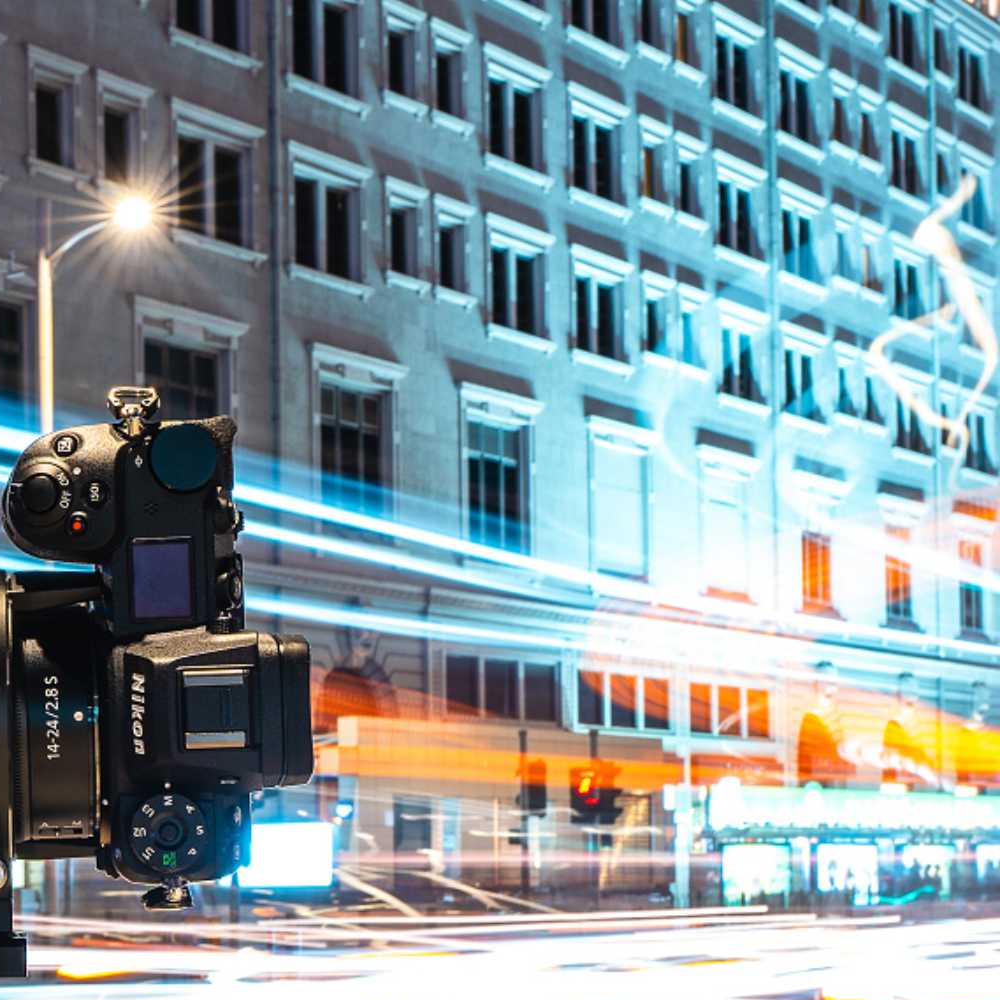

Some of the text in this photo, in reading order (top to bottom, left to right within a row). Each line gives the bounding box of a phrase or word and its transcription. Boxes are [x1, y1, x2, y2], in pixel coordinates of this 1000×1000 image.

[57, 472, 70, 487] ON
[59, 490, 72, 509] OFF
[44, 675, 61, 760] 14-24/2.8 S
[131, 672, 145, 755] Nikon
[163, 795, 173, 806] M
[141, 803, 155, 818] U3
[185, 804, 196, 814] A
[133, 827, 147, 838] U2
[195, 825, 205, 836] S
[187, 847, 197, 856] P
